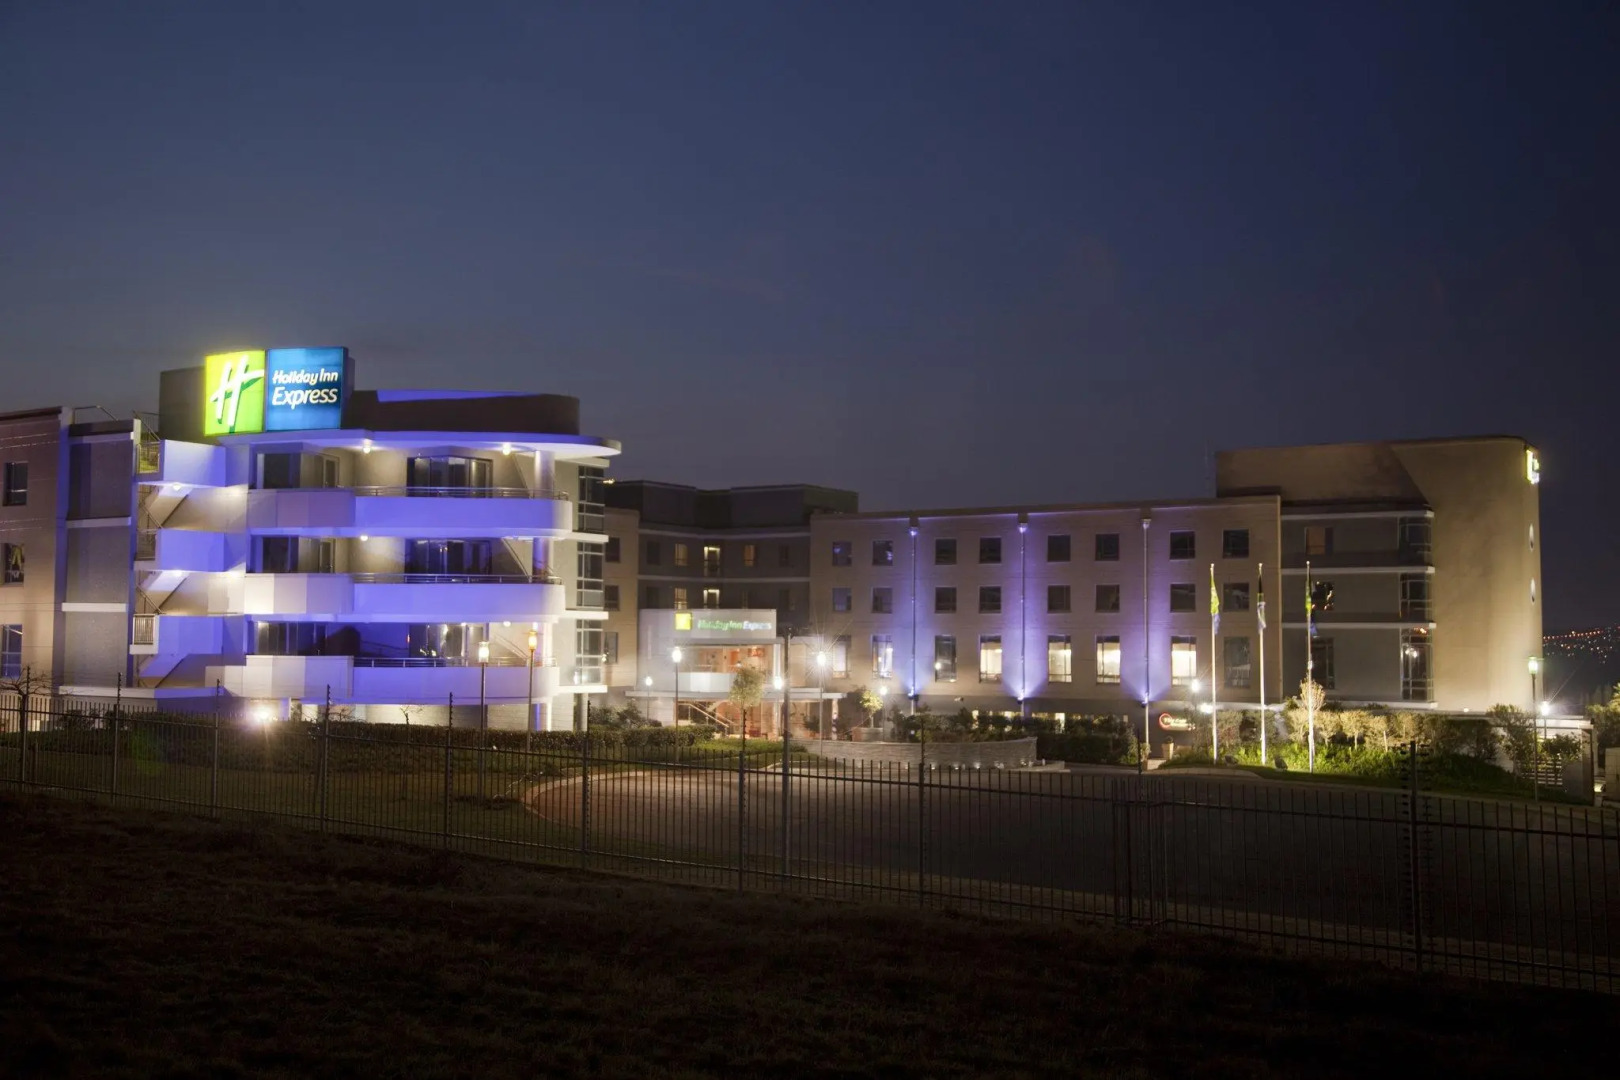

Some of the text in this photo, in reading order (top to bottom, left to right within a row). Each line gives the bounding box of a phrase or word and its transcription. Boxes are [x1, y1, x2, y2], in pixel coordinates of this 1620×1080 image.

[272, 368, 339, 386] Holiday Inn
[272, 386, 338, 410] Express
